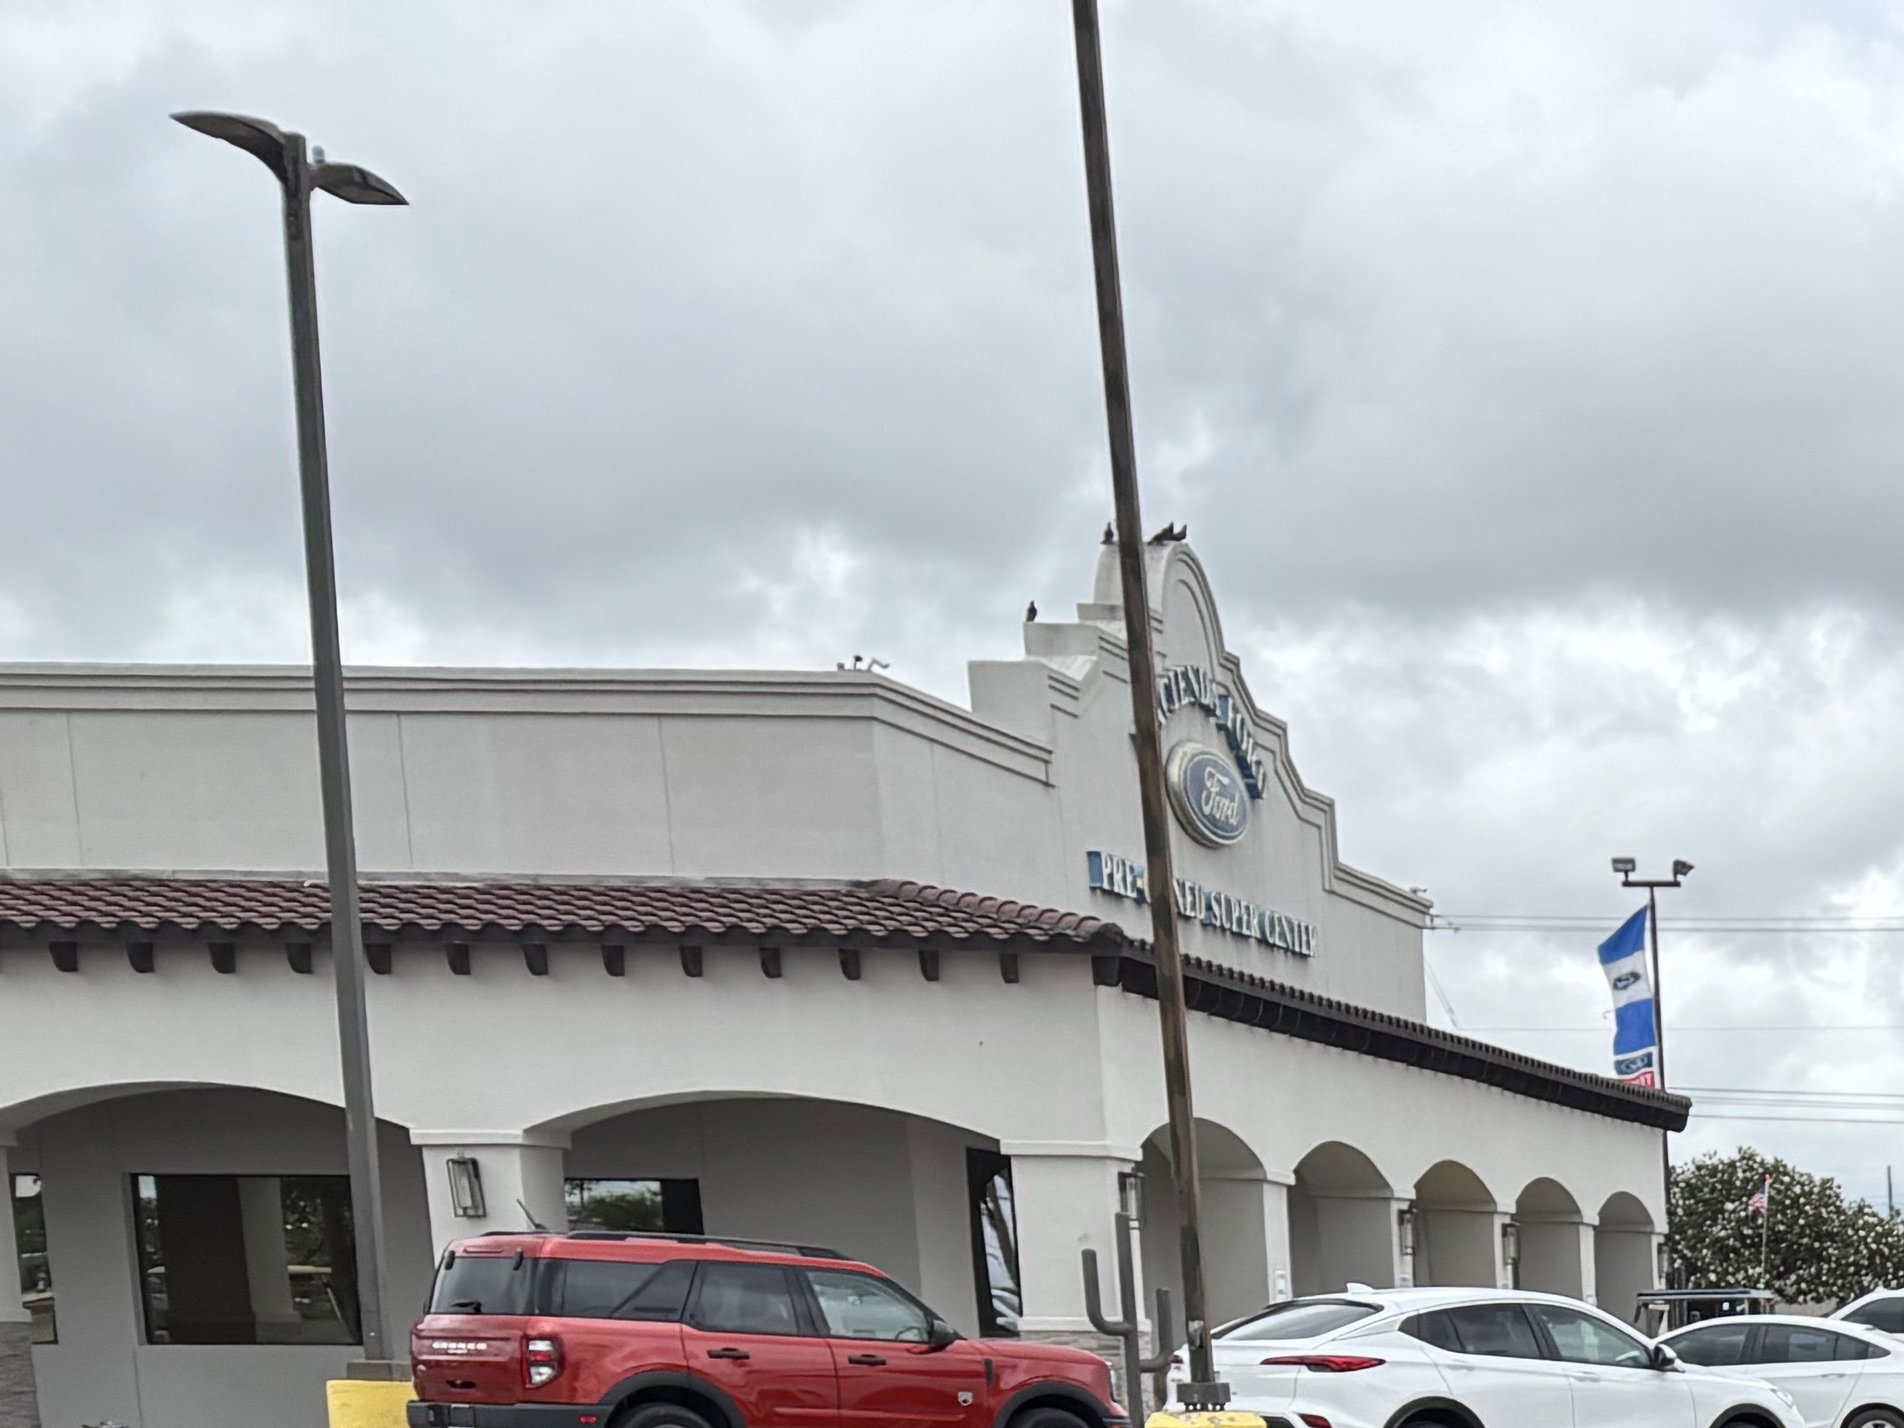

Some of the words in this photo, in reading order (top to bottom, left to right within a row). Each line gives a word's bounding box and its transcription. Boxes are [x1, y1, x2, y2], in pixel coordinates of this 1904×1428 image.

[1201, 766, 1240, 826] Ford
[1210, 891, 1262, 940] SUPER
[1264, 908, 1317, 957] CENTER
